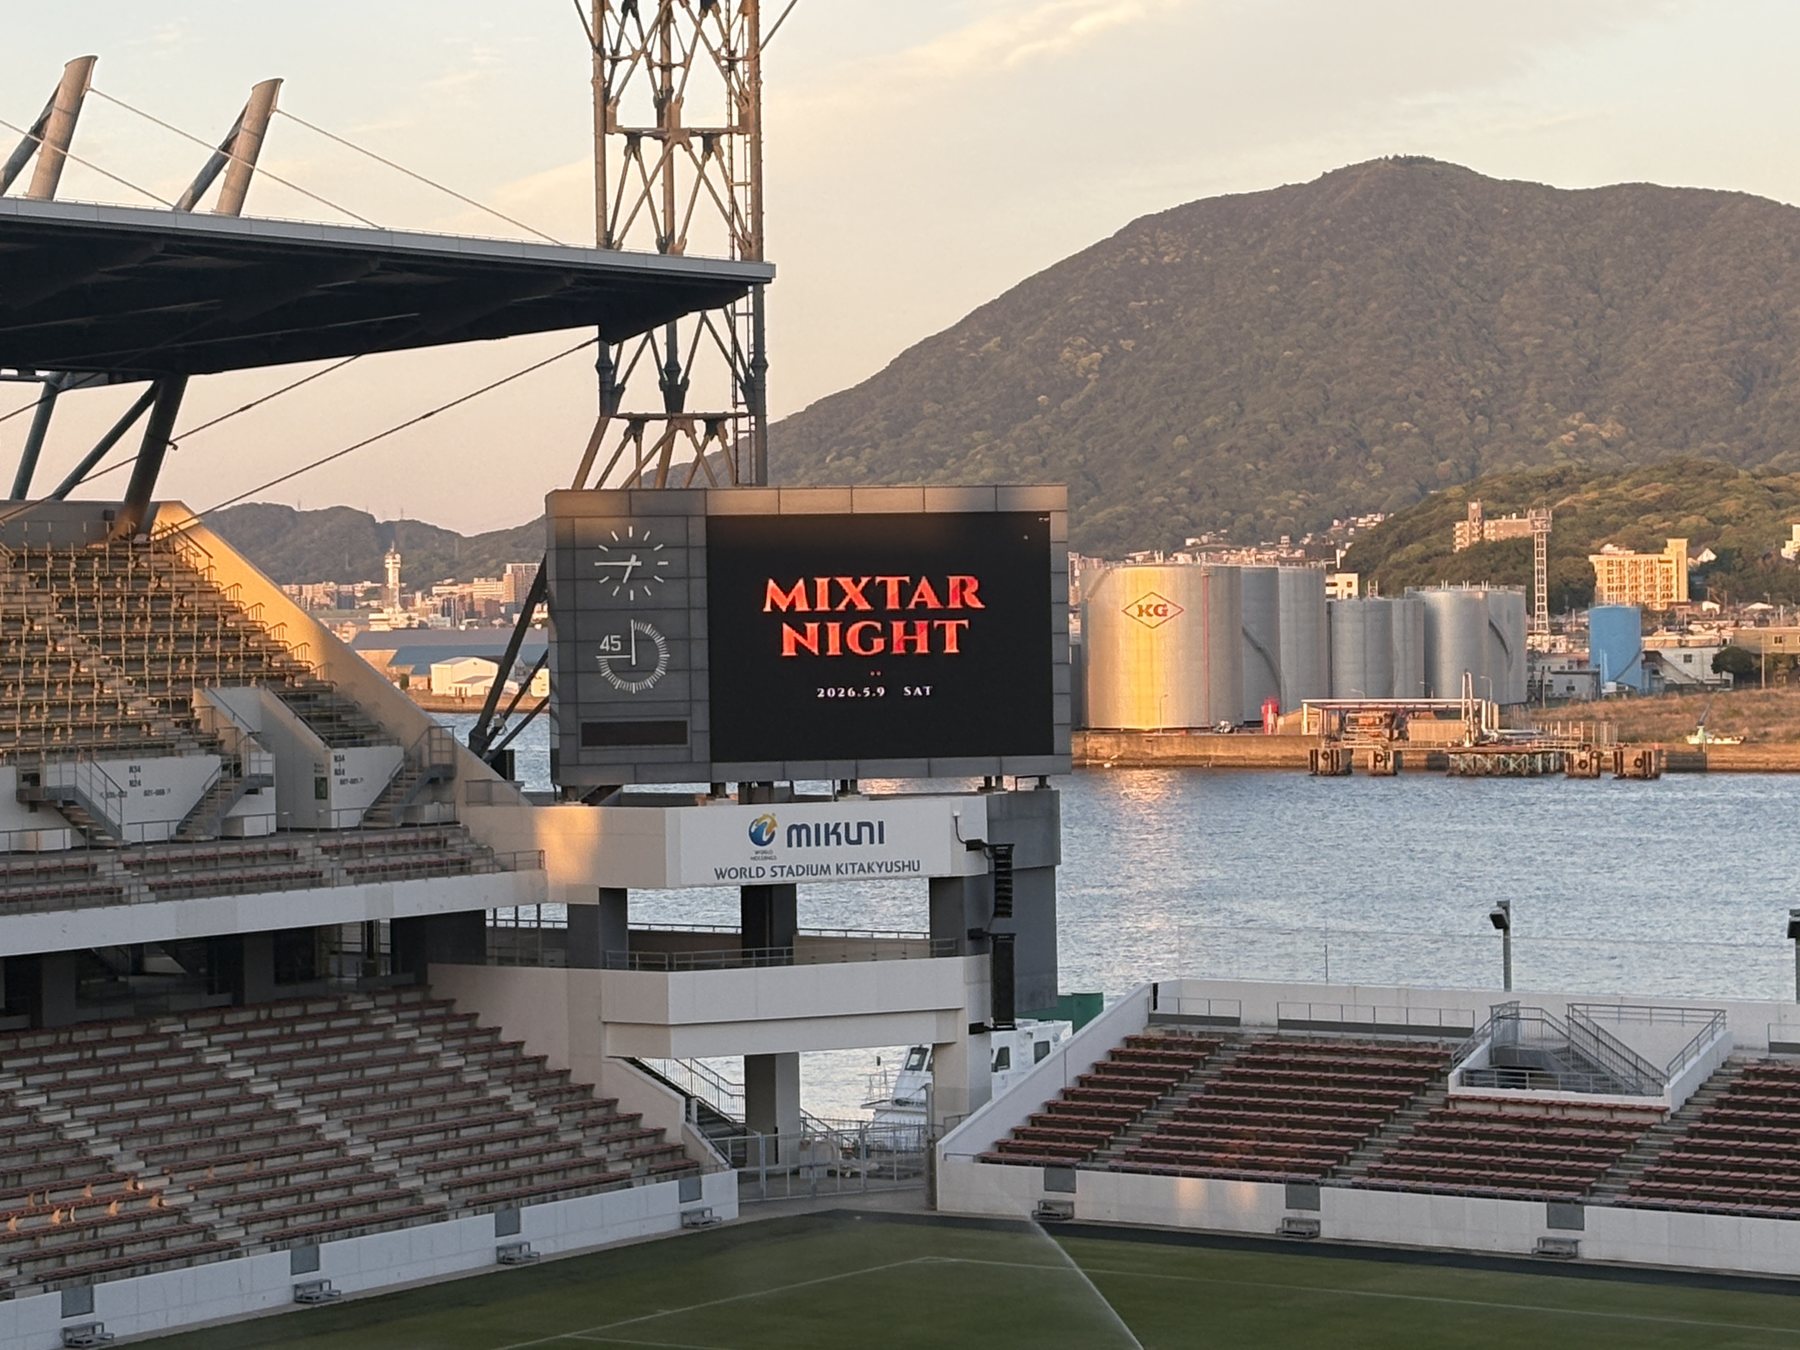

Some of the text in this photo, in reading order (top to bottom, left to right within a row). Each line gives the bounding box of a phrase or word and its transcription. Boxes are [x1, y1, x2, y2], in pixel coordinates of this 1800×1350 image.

[762, 575, 986, 613] MIXTAR
[1137, 603, 1169, 618] KG
[600, 634, 622, 652] 45
[781, 619, 969, 656] NIGHT
[816, 685, 934, 698] 2026.5.9 SAT
[786, 820, 885, 848] MIKUNI
[714, 859, 921, 880] WORLD STADIUM KITAKYUSHU
